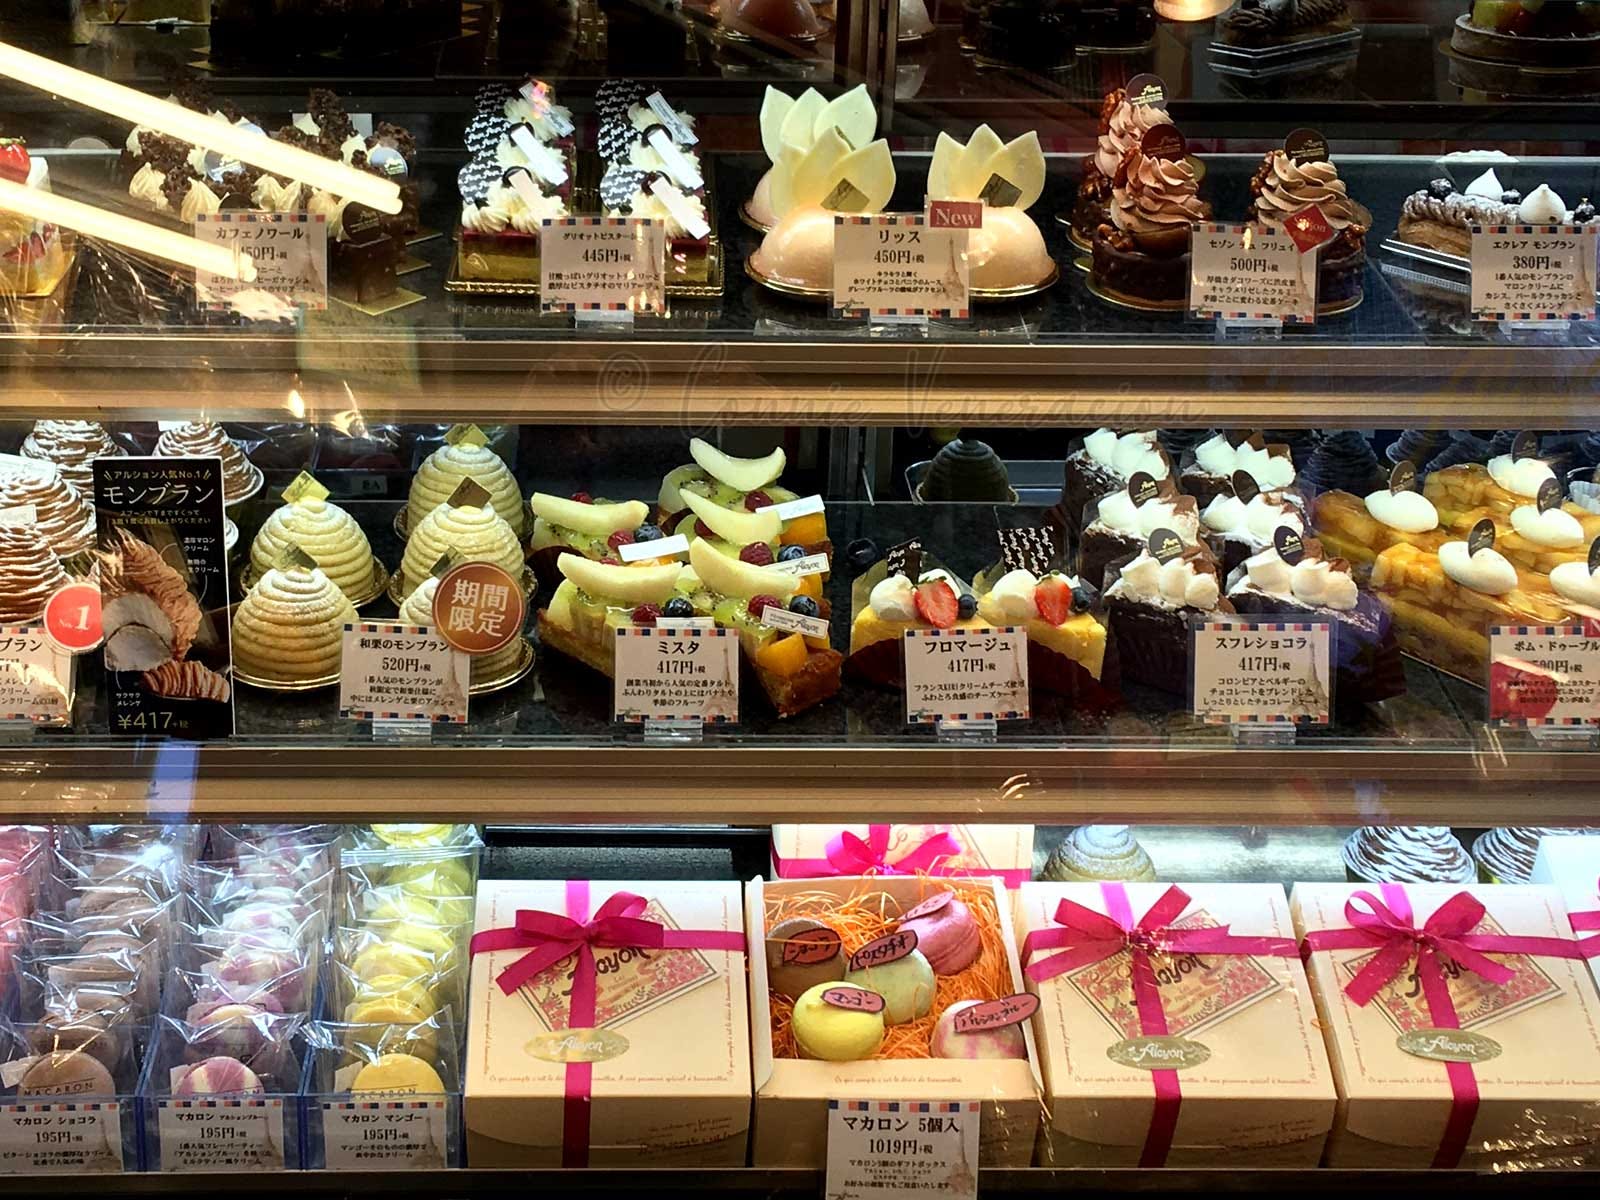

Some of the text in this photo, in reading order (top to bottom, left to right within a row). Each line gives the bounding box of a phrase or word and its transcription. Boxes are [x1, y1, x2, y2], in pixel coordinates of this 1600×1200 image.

[936, 208, 977, 226] New
[216, 227, 304, 240] カフェノワール
[563, 232, 636, 240] グリオットピスターシ
[879, 229, 921, 244] リッス
[1209, 239, 1235, 249] セゾン
[1493, 240, 1576, 249] エクレア モンブラン
[241, 246, 288, 260] 50円+税
[103, 481, 214, 505] モンブラン
[450, 578, 510, 612] 期間
[447, 606, 506, 638] 限定
[360, 638, 449, 651] 和栗のモンブラン
[657, 640, 699, 655] ミスタ
[925, 637, 1011, 654] フロマージュ
[1216, 637, 1307, 649] スフレショコラ
[13, 1116, 52, 1126] マカロン
[176, 1113, 215, 1121] マカロン
[341, 1113, 423, 1123] マカロン マンゴー
[843, 1116, 960, 1133] マカロン 5個入
